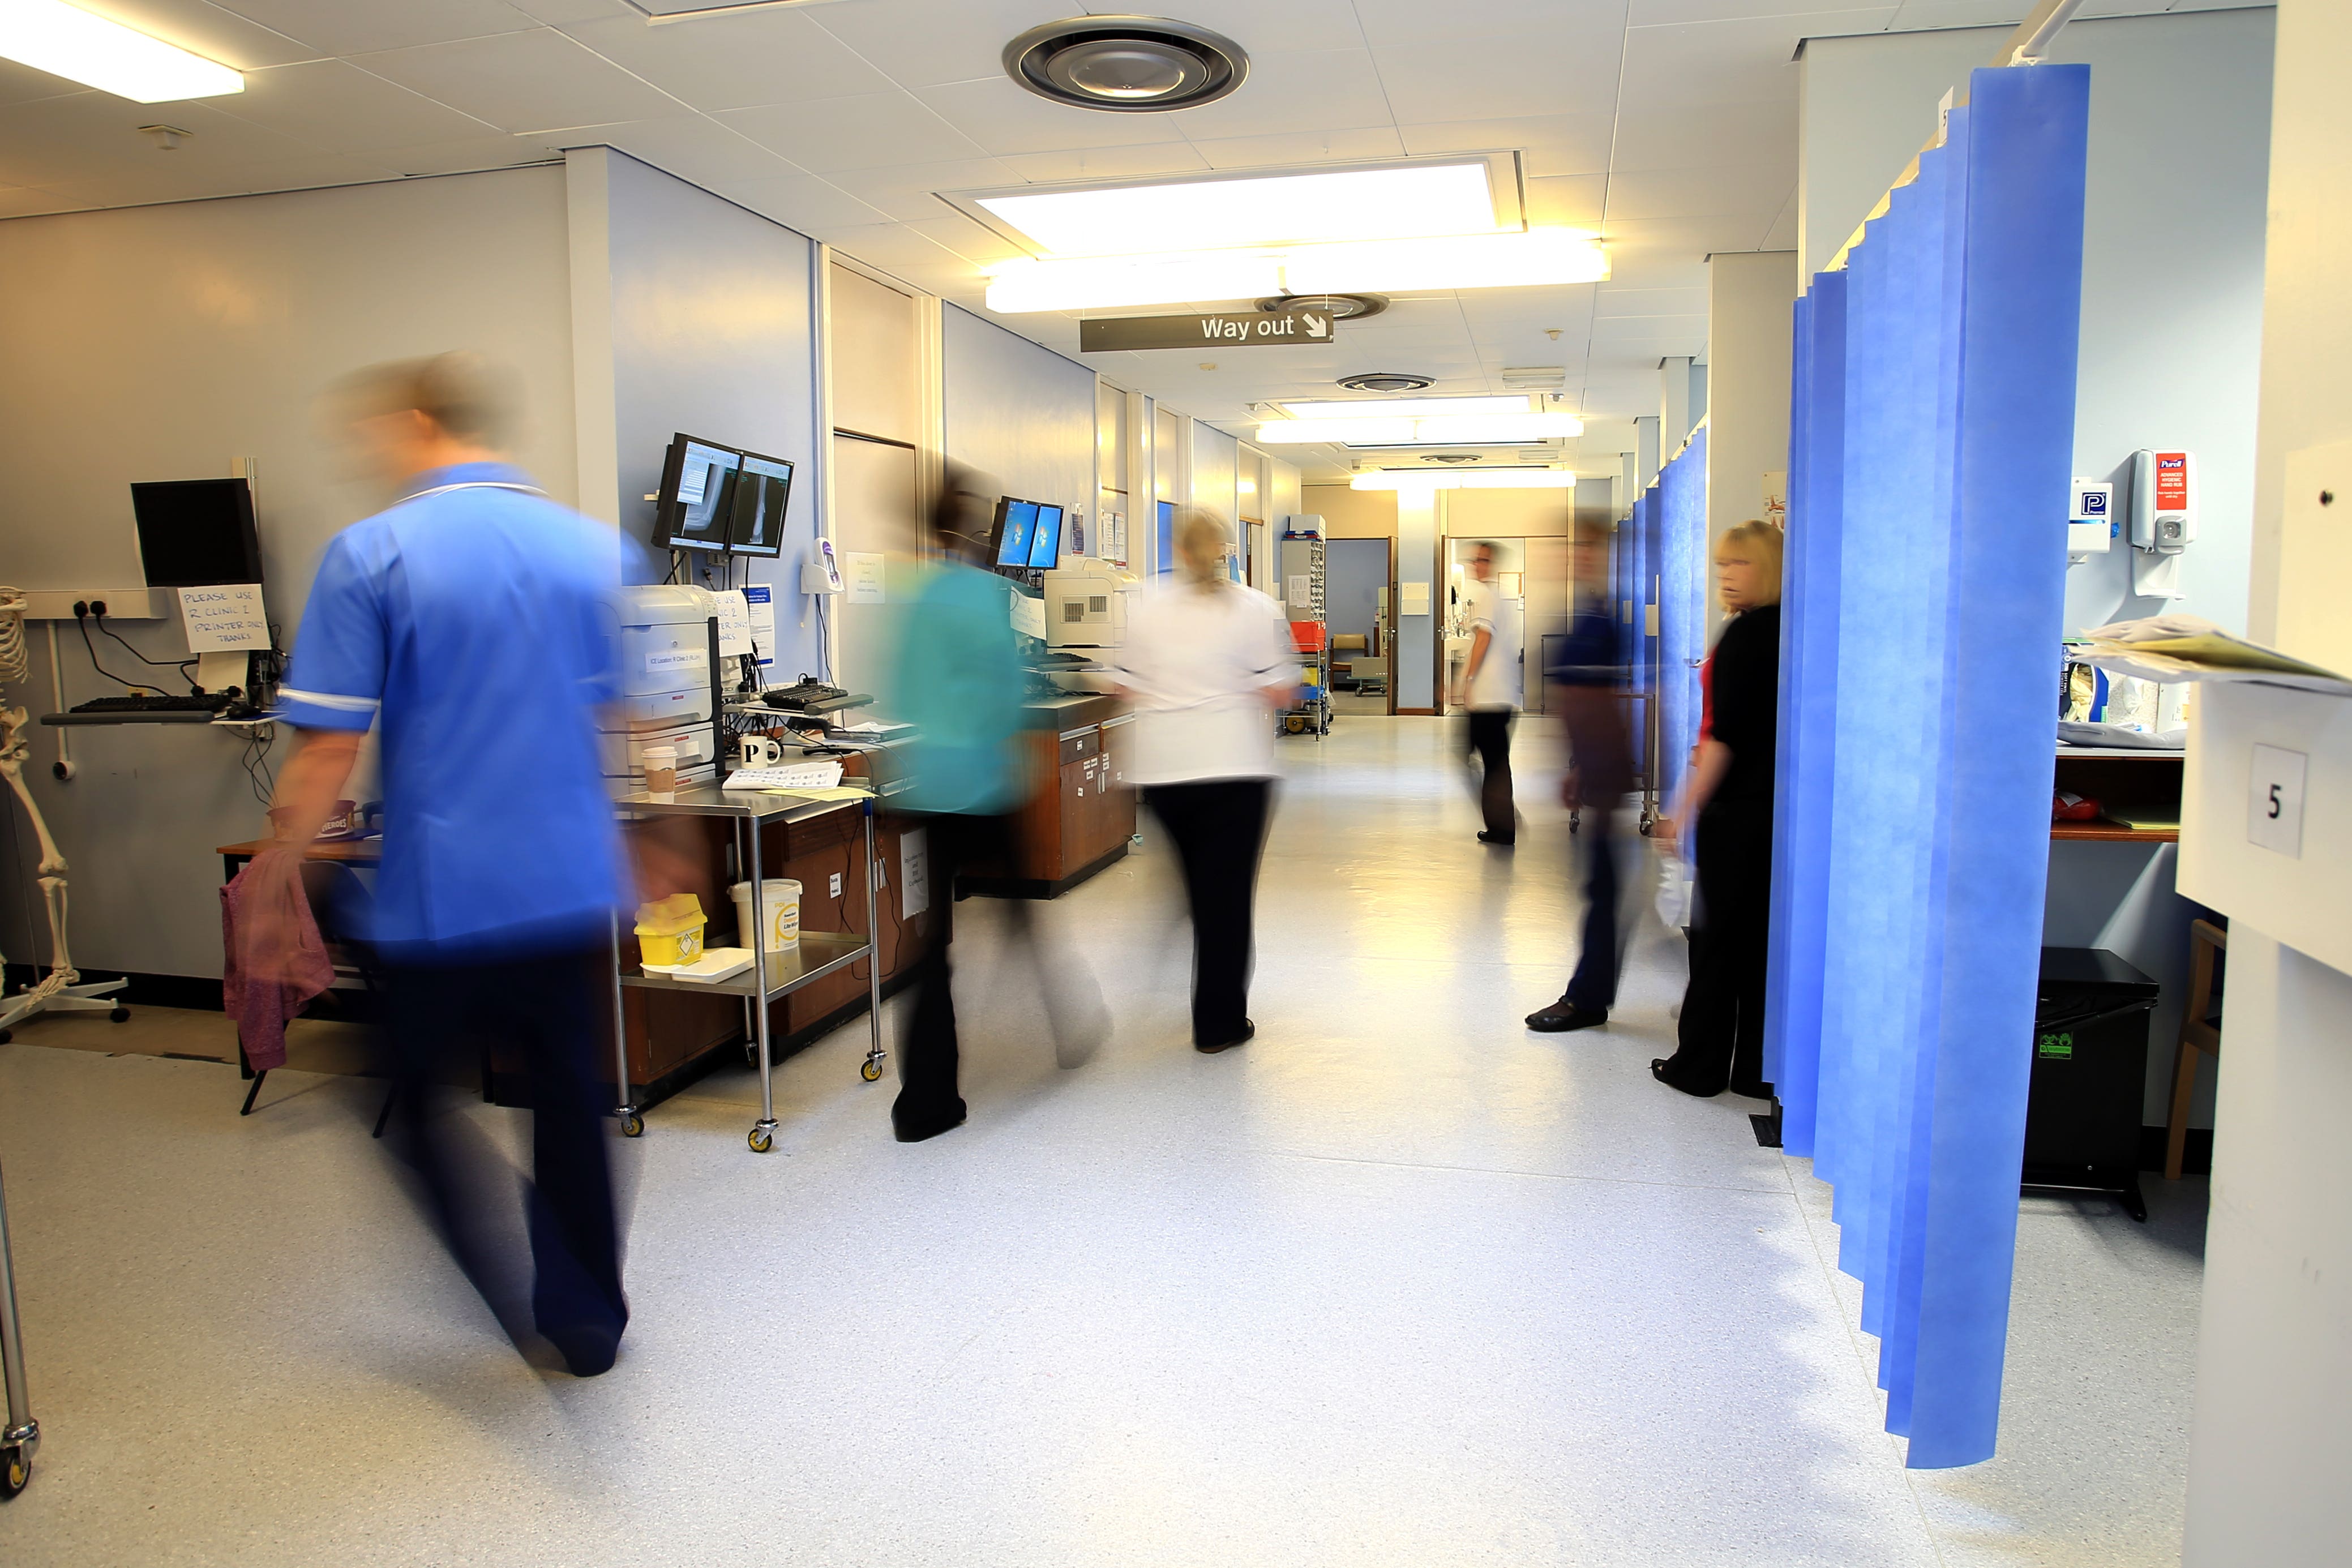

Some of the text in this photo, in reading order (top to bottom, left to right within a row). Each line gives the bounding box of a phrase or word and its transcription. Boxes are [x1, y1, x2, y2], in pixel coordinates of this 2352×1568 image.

[1201, 315, 1294, 340] Way out
[184, 592, 253, 603] PLEASE USE
[205, 606, 238, 616] CLINIC
[243, 605, 250, 614] 2
[731, 607, 738, 617] 2
[195, 621, 245, 632] PRINTER
[743, 744, 759, 762] P
[2268, 783, 2282, 819] 5
